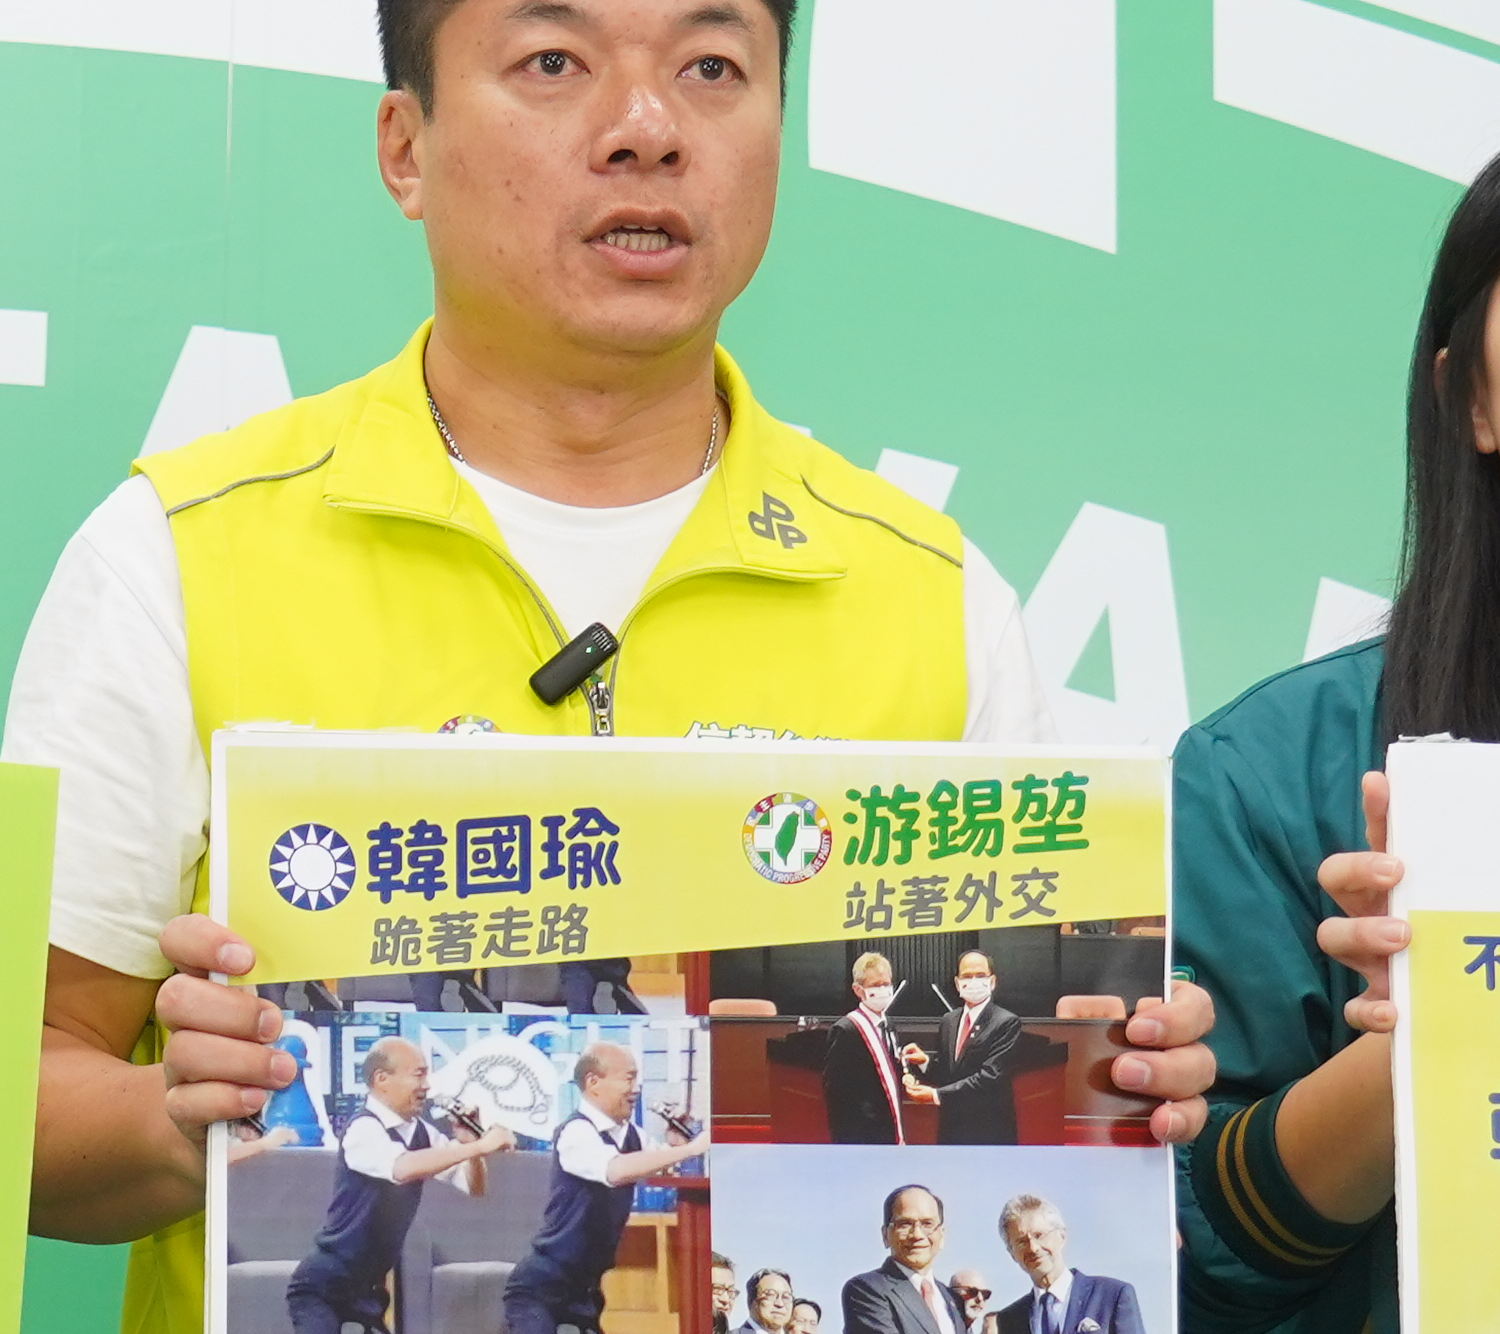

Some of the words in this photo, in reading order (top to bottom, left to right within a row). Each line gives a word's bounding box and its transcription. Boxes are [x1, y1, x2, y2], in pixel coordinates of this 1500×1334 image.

[366, 806, 622, 905] 韓國瑜
[842, 771, 1091, 867] 游錫堃
[370, 903, 590, 966] 跪著走路
[843, 867, 1060, 933] 站著外交
